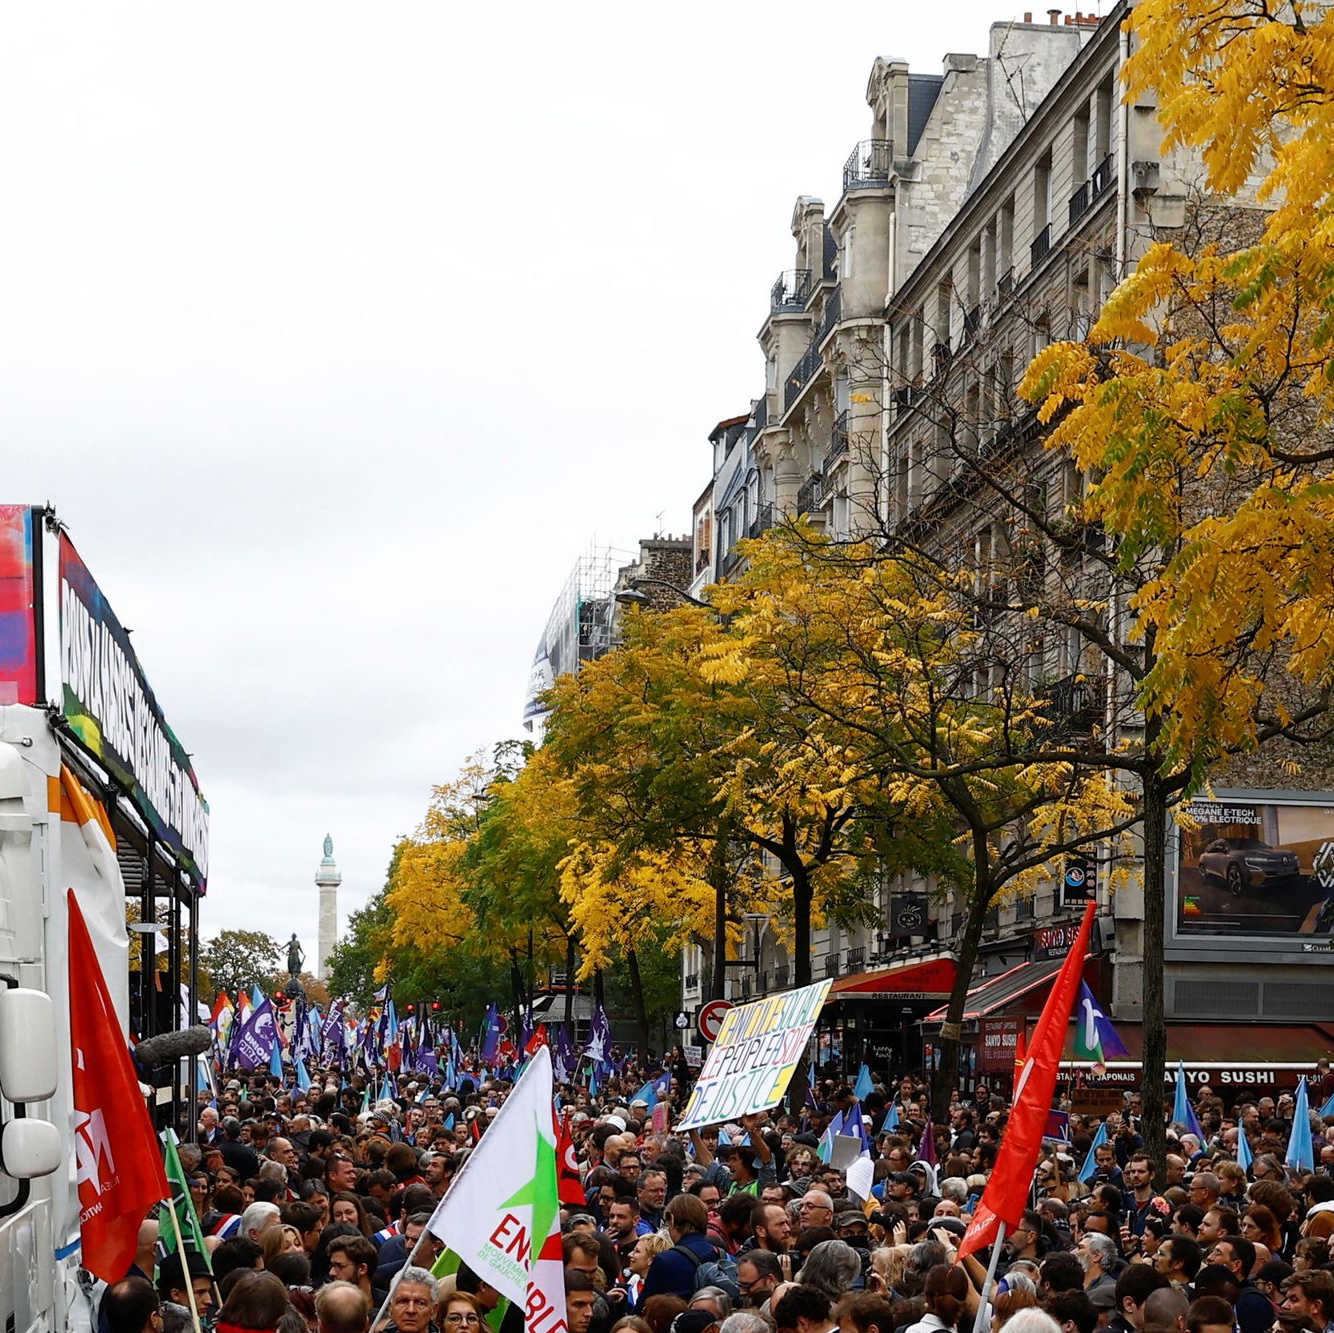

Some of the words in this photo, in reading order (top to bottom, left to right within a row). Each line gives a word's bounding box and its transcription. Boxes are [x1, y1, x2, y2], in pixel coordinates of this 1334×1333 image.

[1223, 808, 1254, 817] E-TECH
[244, 1031, 271, 1063] UNION
[984, 1034, 1001, 1047] SANYO
[1164, 1071, 1211, 1084] ANYO
[1220, 1071, 1275, 1084] SUSHI
[701, 1062, 795, 1122] JUSTICE
[477, 1250, 487, 1263] DE
[483, 1243, 529, 1283] MOUVEMEN
